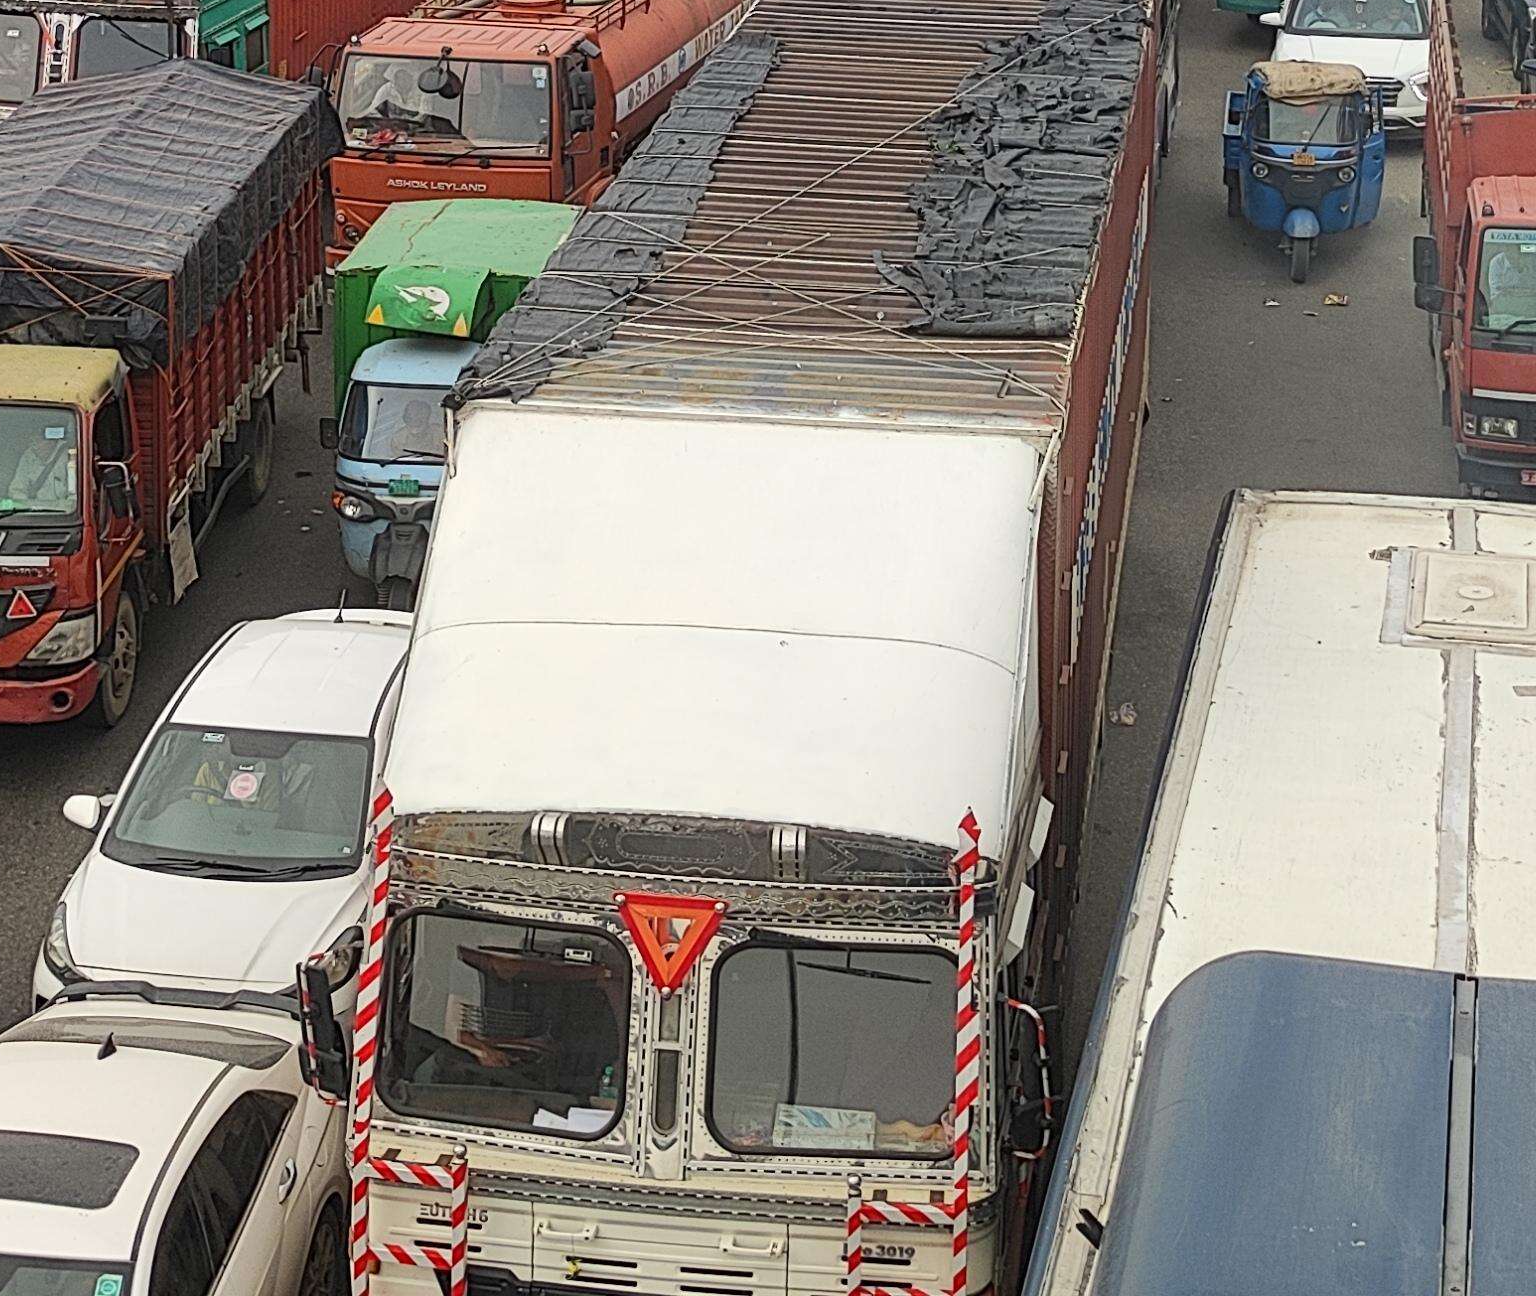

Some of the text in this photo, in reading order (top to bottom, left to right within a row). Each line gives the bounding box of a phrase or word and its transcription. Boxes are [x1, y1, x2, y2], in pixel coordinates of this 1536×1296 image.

[387, 178, 487, 192] ASHOK LEYLAND
[420, 1201, 489, 1224] EUTH6
[874, 1243, 916, 1258] 3019
